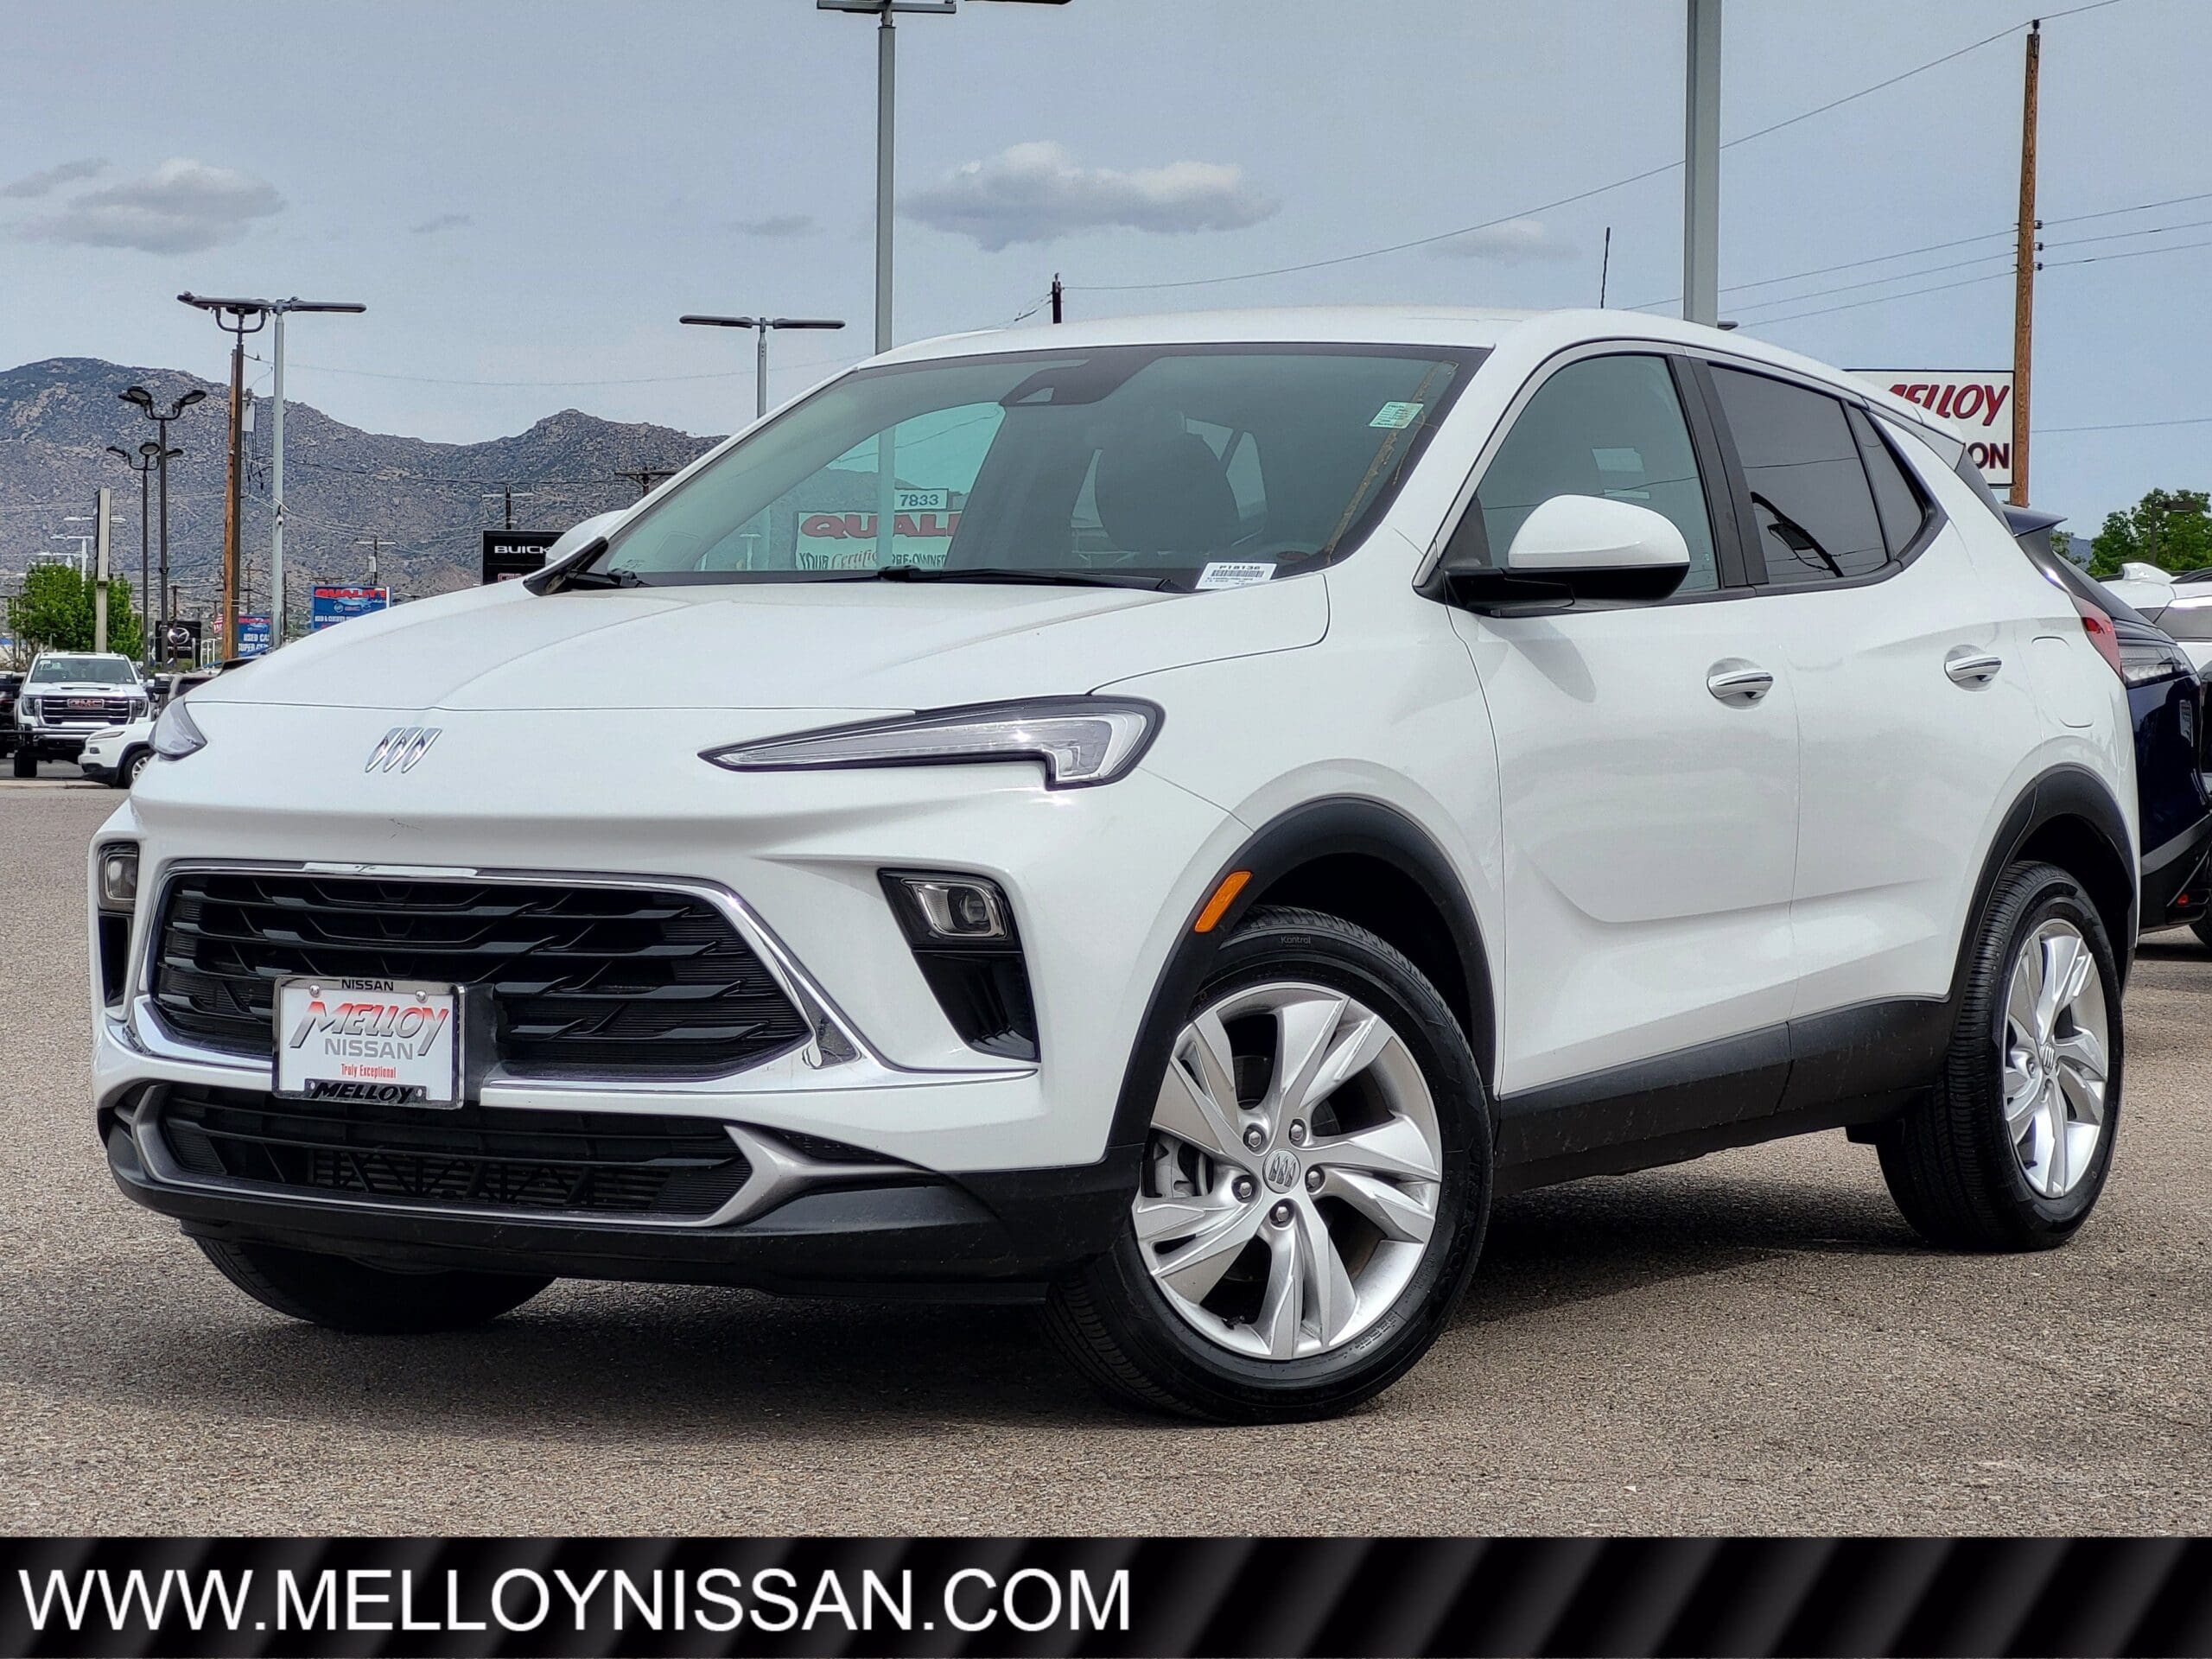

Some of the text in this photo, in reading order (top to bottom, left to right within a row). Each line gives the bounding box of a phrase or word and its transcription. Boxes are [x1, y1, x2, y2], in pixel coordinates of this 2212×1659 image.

[1889, 384, 2010, 426] ELLOY
[899, 493, 939, 506] 7833
[494, 545, 551, 554] BUICK
[341, 979, 394, 992] NISSAN
[289, 1001, 449, 1056] MELLOY
[325, 1039, 413, 1060] NISSAN
[341, 1064, 397, 1078] Truly Exceptional
[310, 1082, 414, 1104] MELLOY
